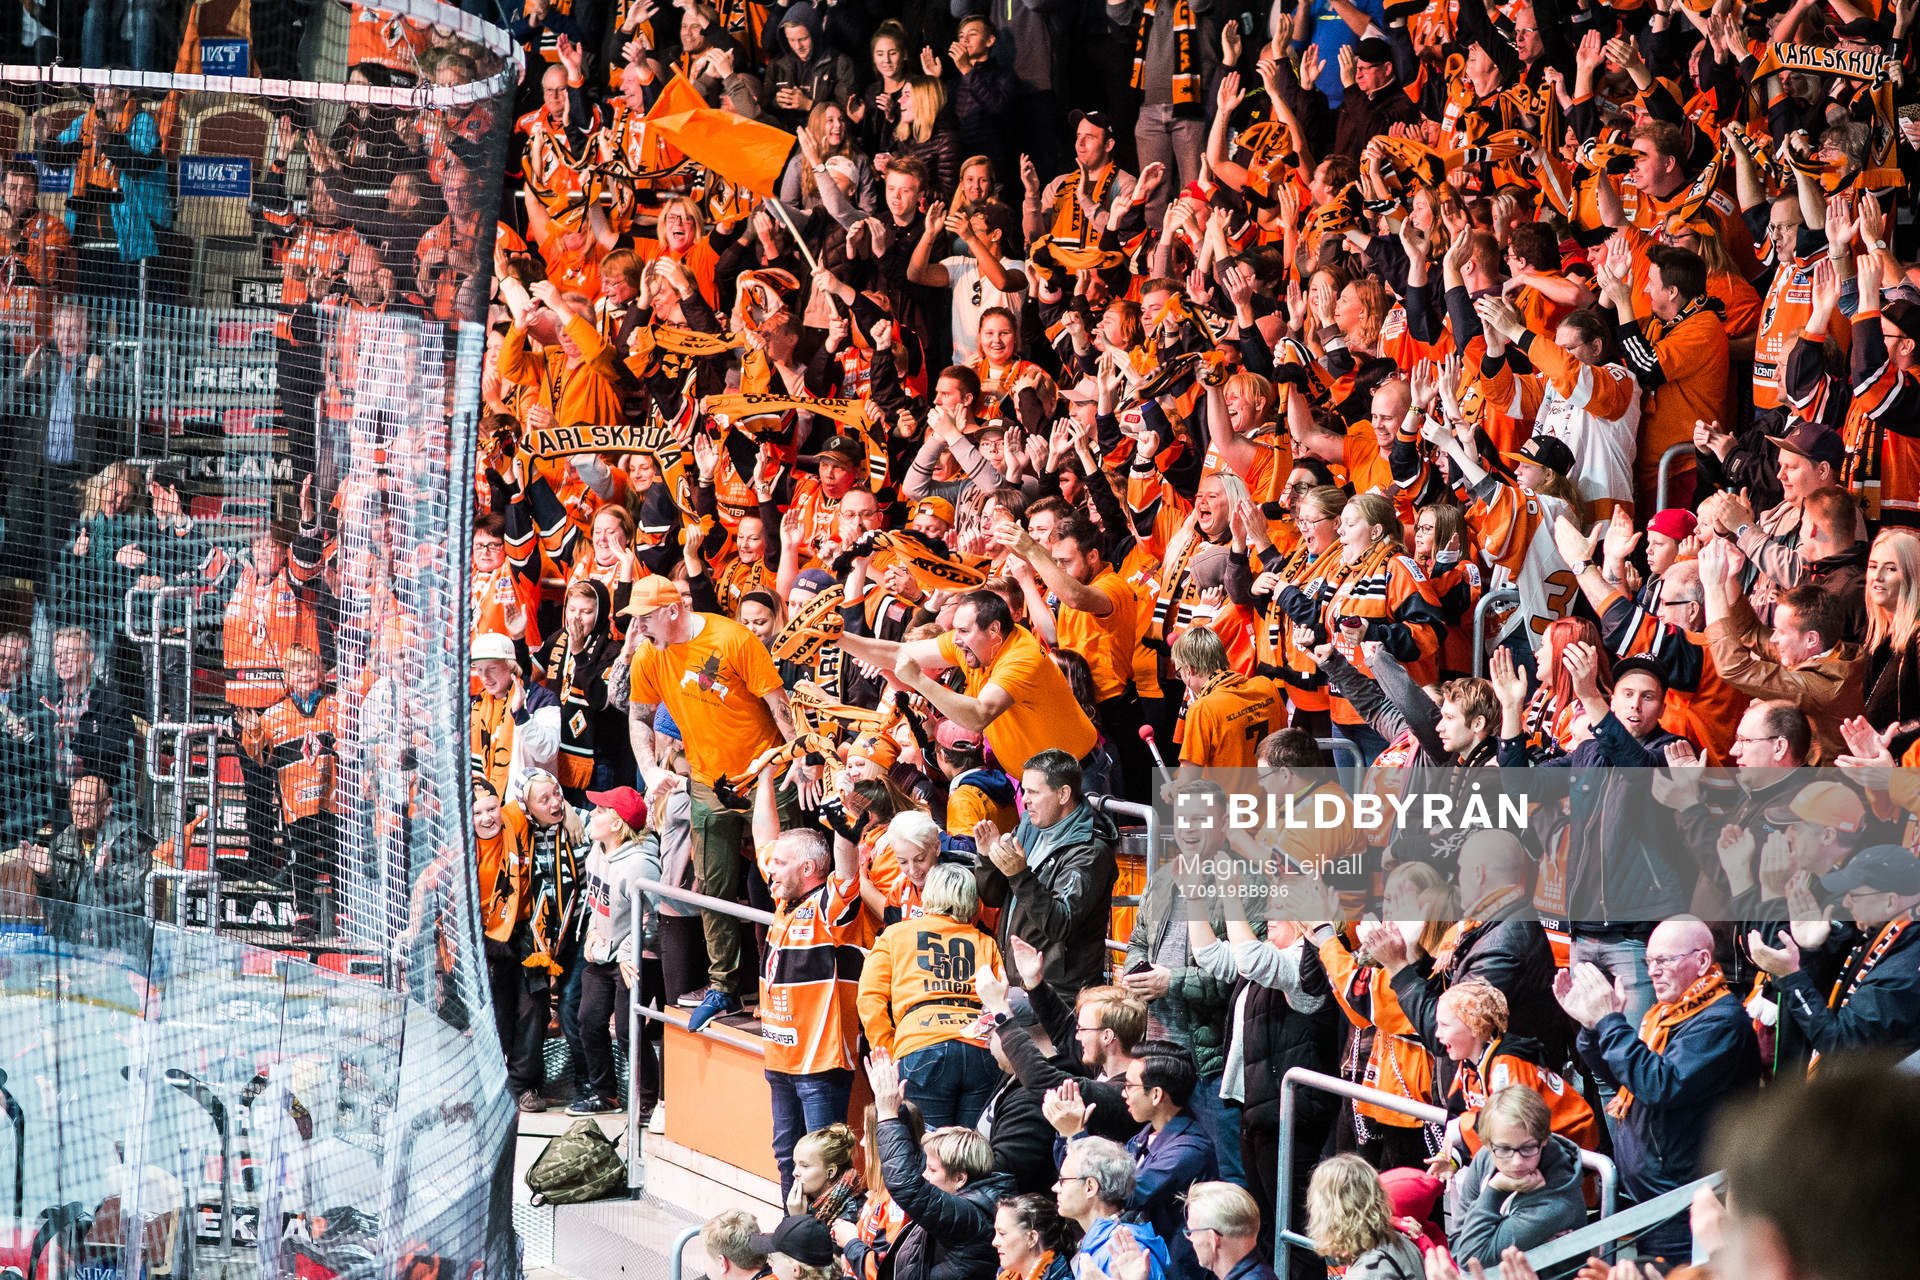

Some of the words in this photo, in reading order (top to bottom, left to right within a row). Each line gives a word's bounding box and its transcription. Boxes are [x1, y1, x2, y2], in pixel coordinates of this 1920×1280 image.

[188, 163, 243, 182] NKT
[1245, 720, 1269, 755] 7
[917, 931, 975, 976] 50
[933, 953, 970, 982] 50
